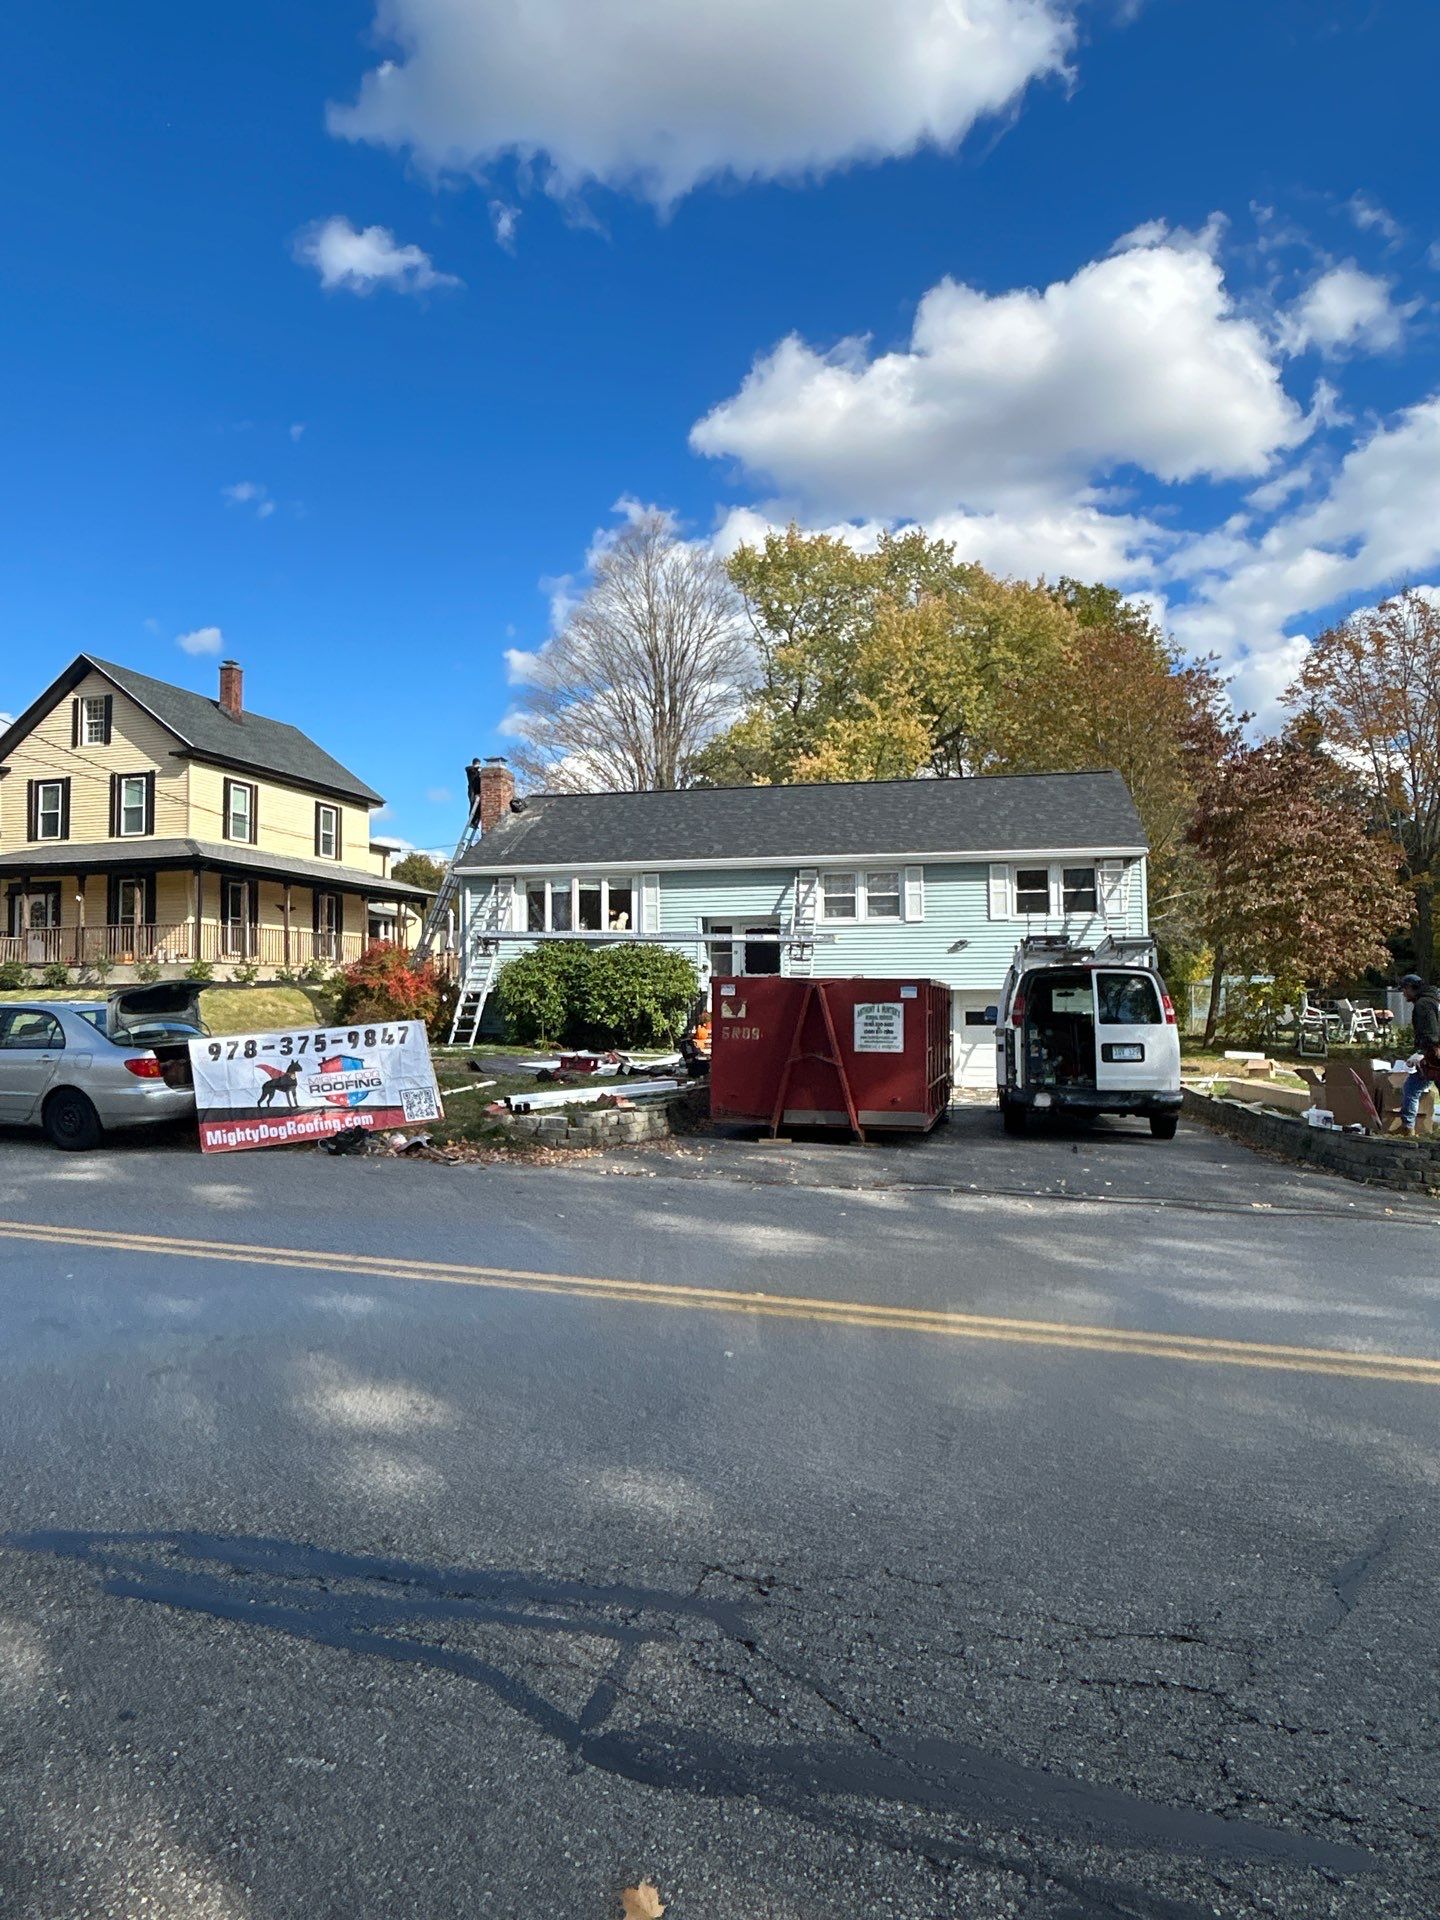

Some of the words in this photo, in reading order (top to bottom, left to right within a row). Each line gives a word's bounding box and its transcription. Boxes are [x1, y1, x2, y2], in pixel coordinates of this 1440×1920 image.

[208, 1026, 409, 1061] 978-375-9847
[308, 1073, 352, 1085] MIGHTY
[355, 1070, 380, 1080] DOG
[309, 1077, 383, 1094] ROOFING
[206, 1114, 374, 1146] MightyDogRoofing.com
